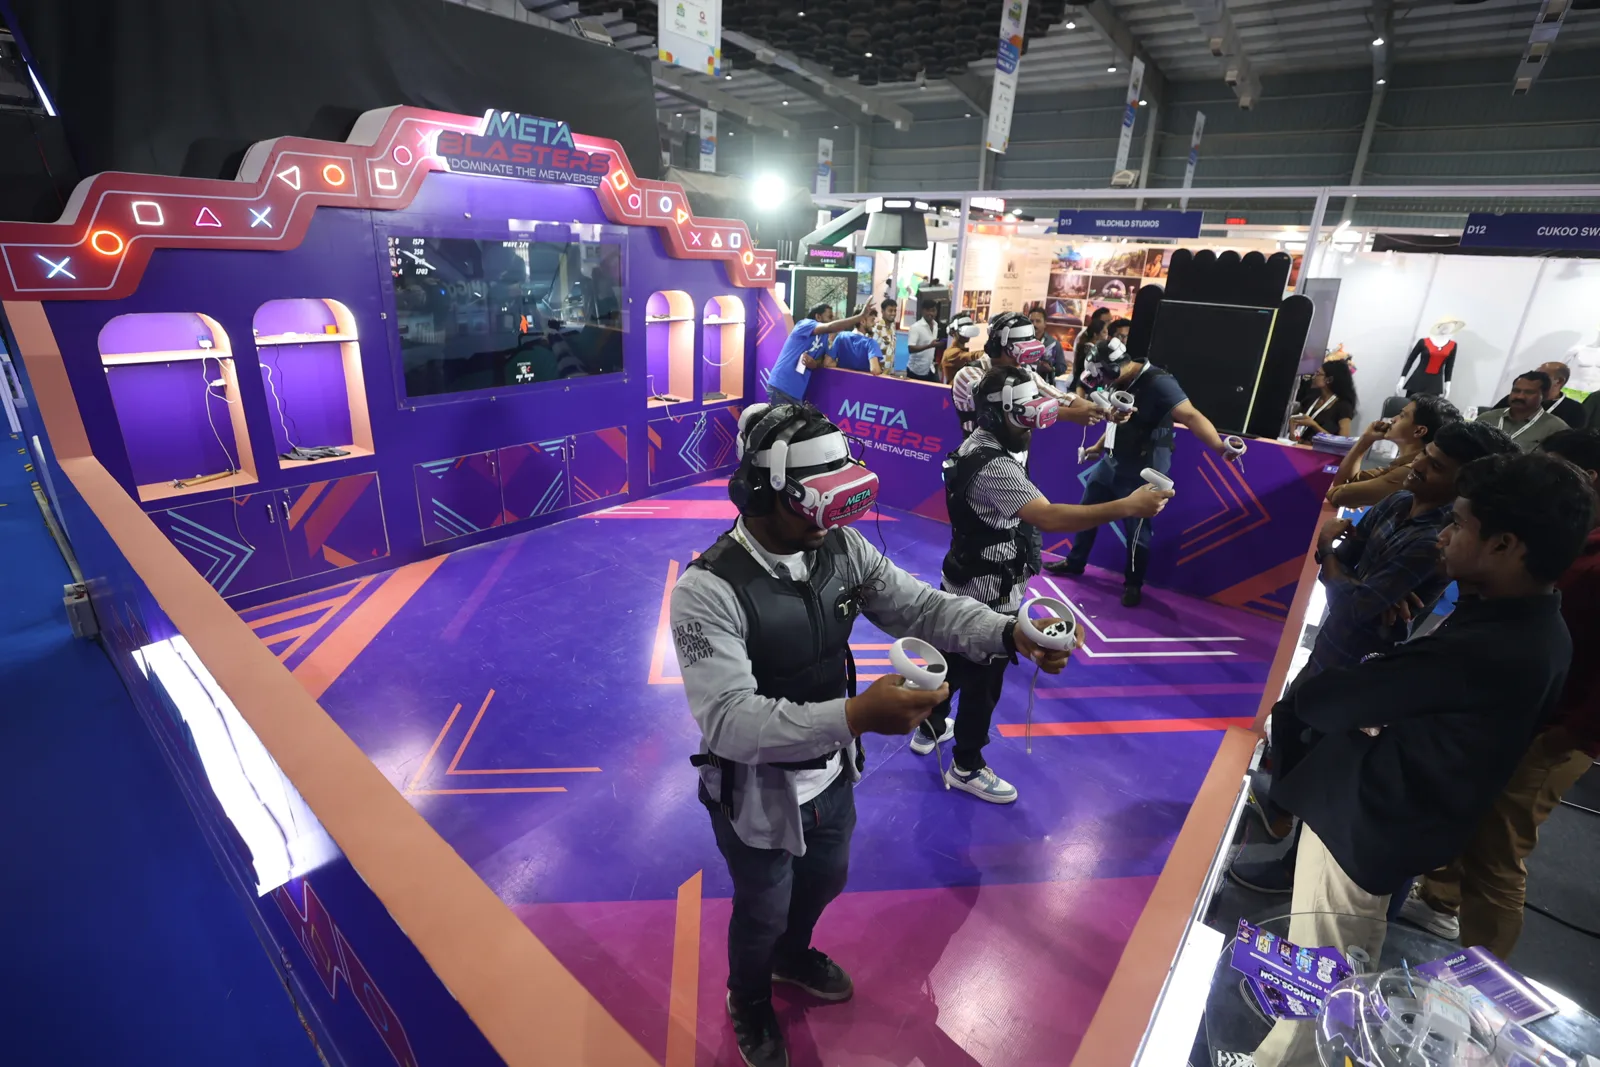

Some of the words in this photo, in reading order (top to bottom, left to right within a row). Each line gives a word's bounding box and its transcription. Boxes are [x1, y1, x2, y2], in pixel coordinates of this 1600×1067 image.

[487, 113, 573, 148] META
[440, 133, 610, 173] BLASTERS
[516, 166, 537, 178] THE
[1060, 218, 1072, 226] D13
[1096, 219, 1130, 228] WILDCHILD
[1131, 219, 1160, 228] STUDIOS
[1466, 225, 1487, 235] D12
[1536, 226, 1578, 236] CUKOO
[1580, 226, 1600, 237] SW
[838, 399, 909, 429] META
[837, 418, 944, 453] ASTERS
[845, 488, 871, 507] META
[1260, 969, 1322, 1007] BAMIGOS.COM
